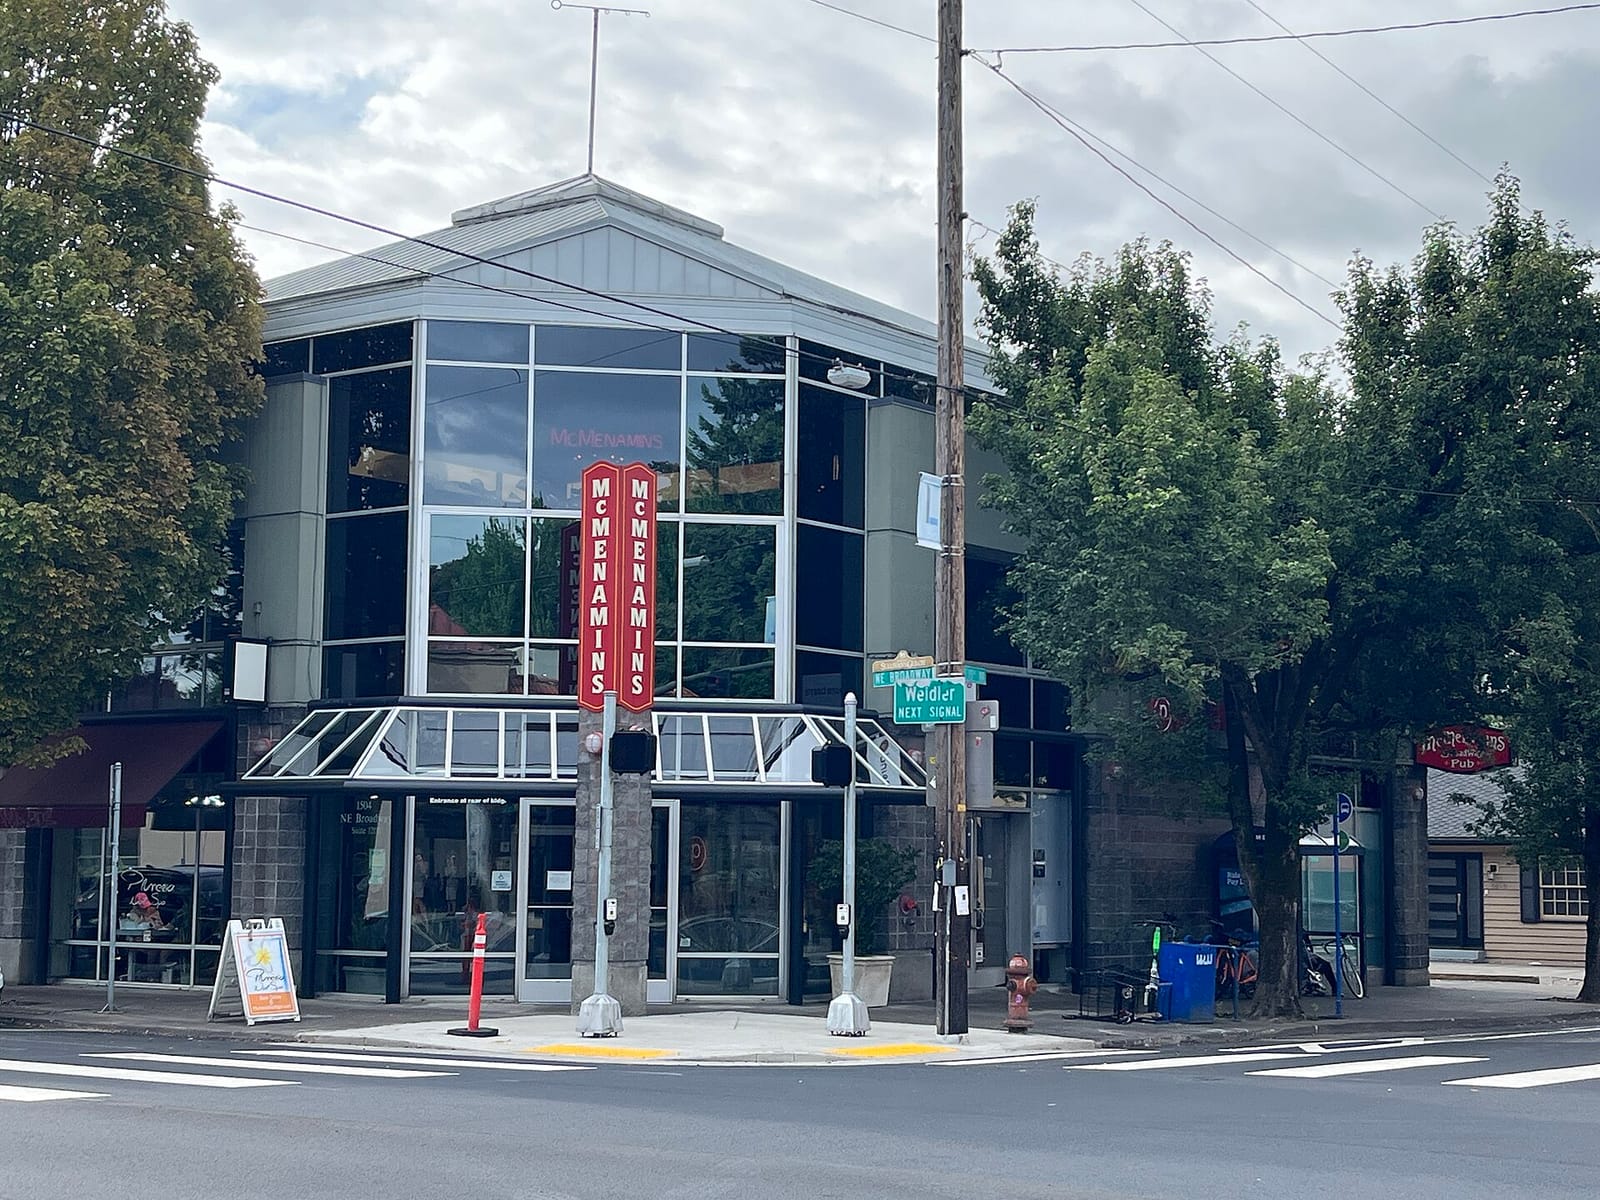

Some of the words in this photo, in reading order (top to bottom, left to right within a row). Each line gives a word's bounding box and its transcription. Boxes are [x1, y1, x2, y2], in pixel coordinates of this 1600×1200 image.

[905, 686, 955, 702] Weidler
[898, 707, 922, 719] NEXT
[929, 706, 962, 717] SIGNAL
[1451, 758, 1475, 768] Pub
[340, 813, 353, 824] NE
